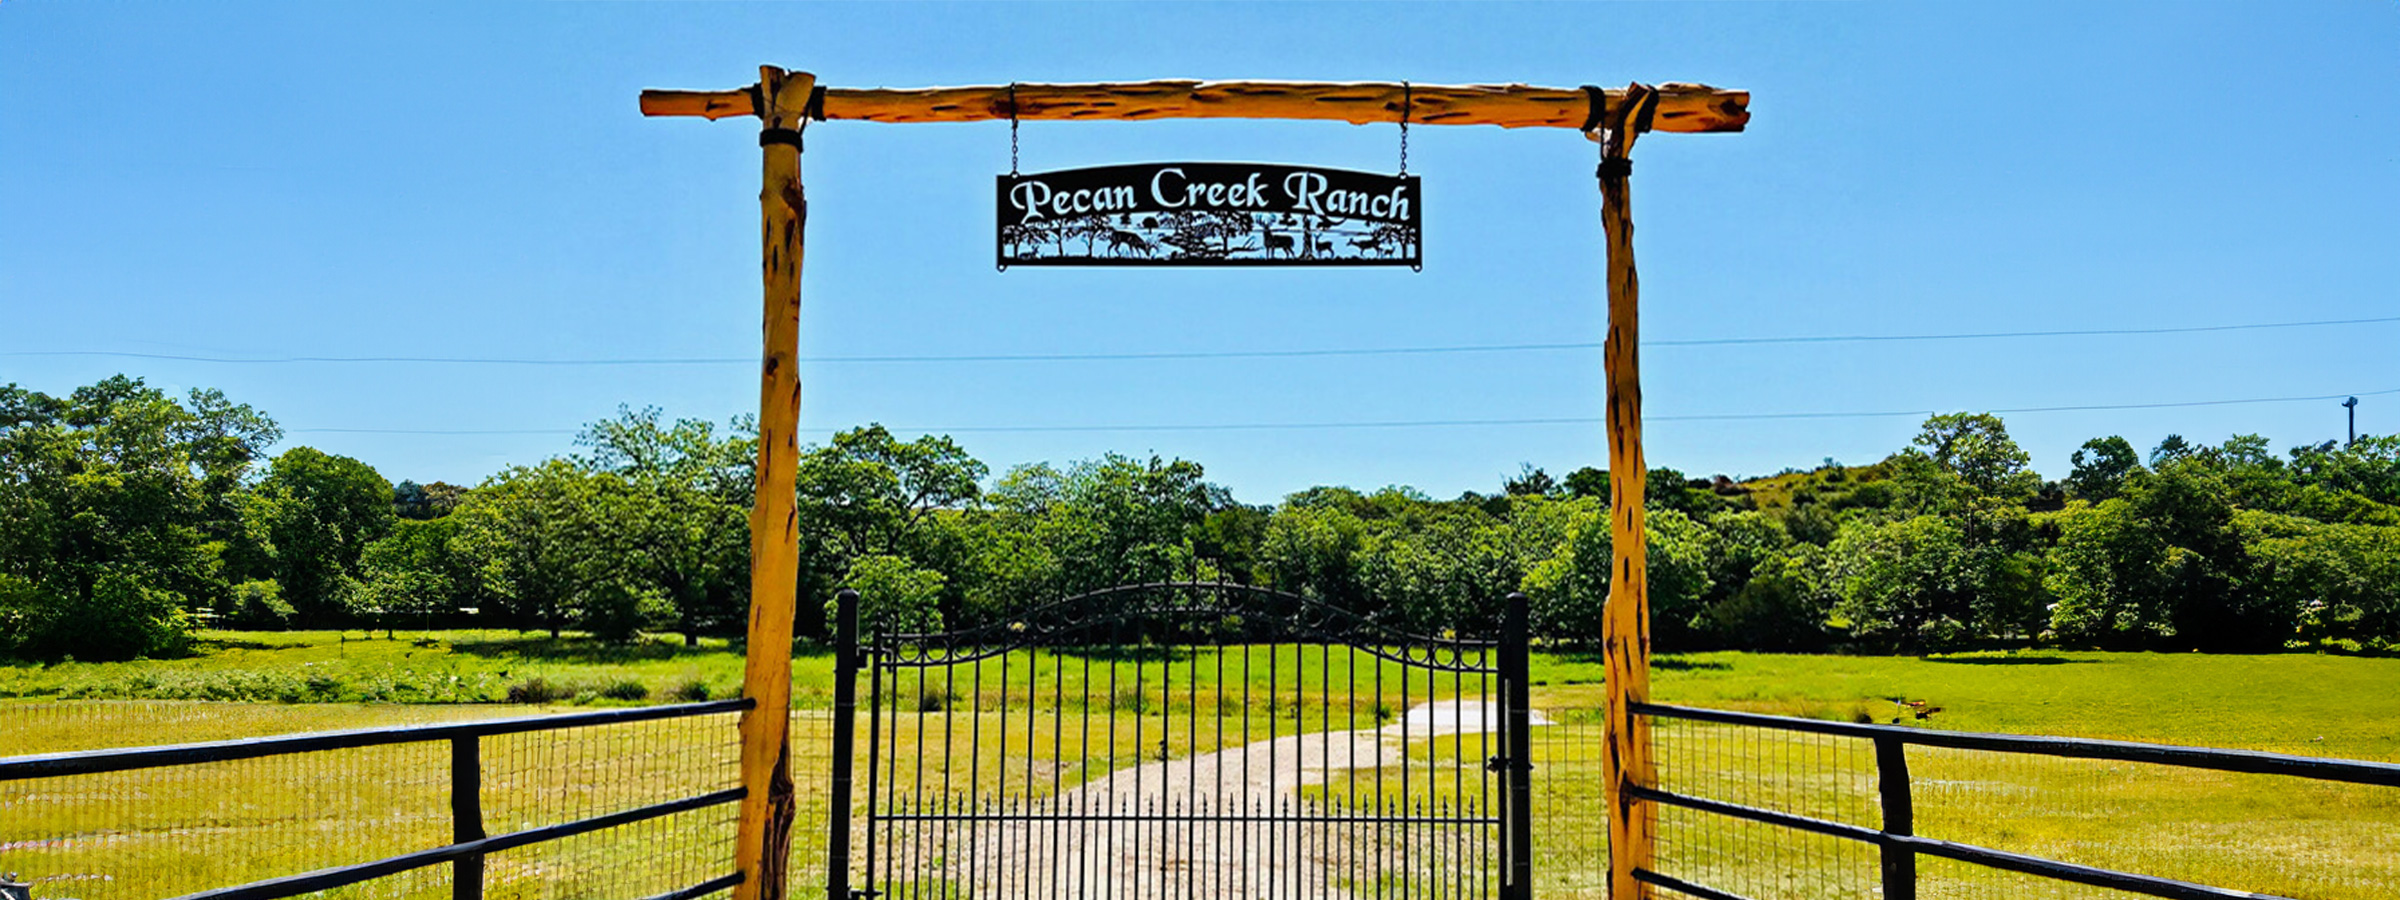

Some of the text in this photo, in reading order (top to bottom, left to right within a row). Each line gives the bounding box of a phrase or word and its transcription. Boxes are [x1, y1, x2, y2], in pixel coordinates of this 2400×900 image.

[1010, 168, 1410, 222] Pecan Creek Ranch
